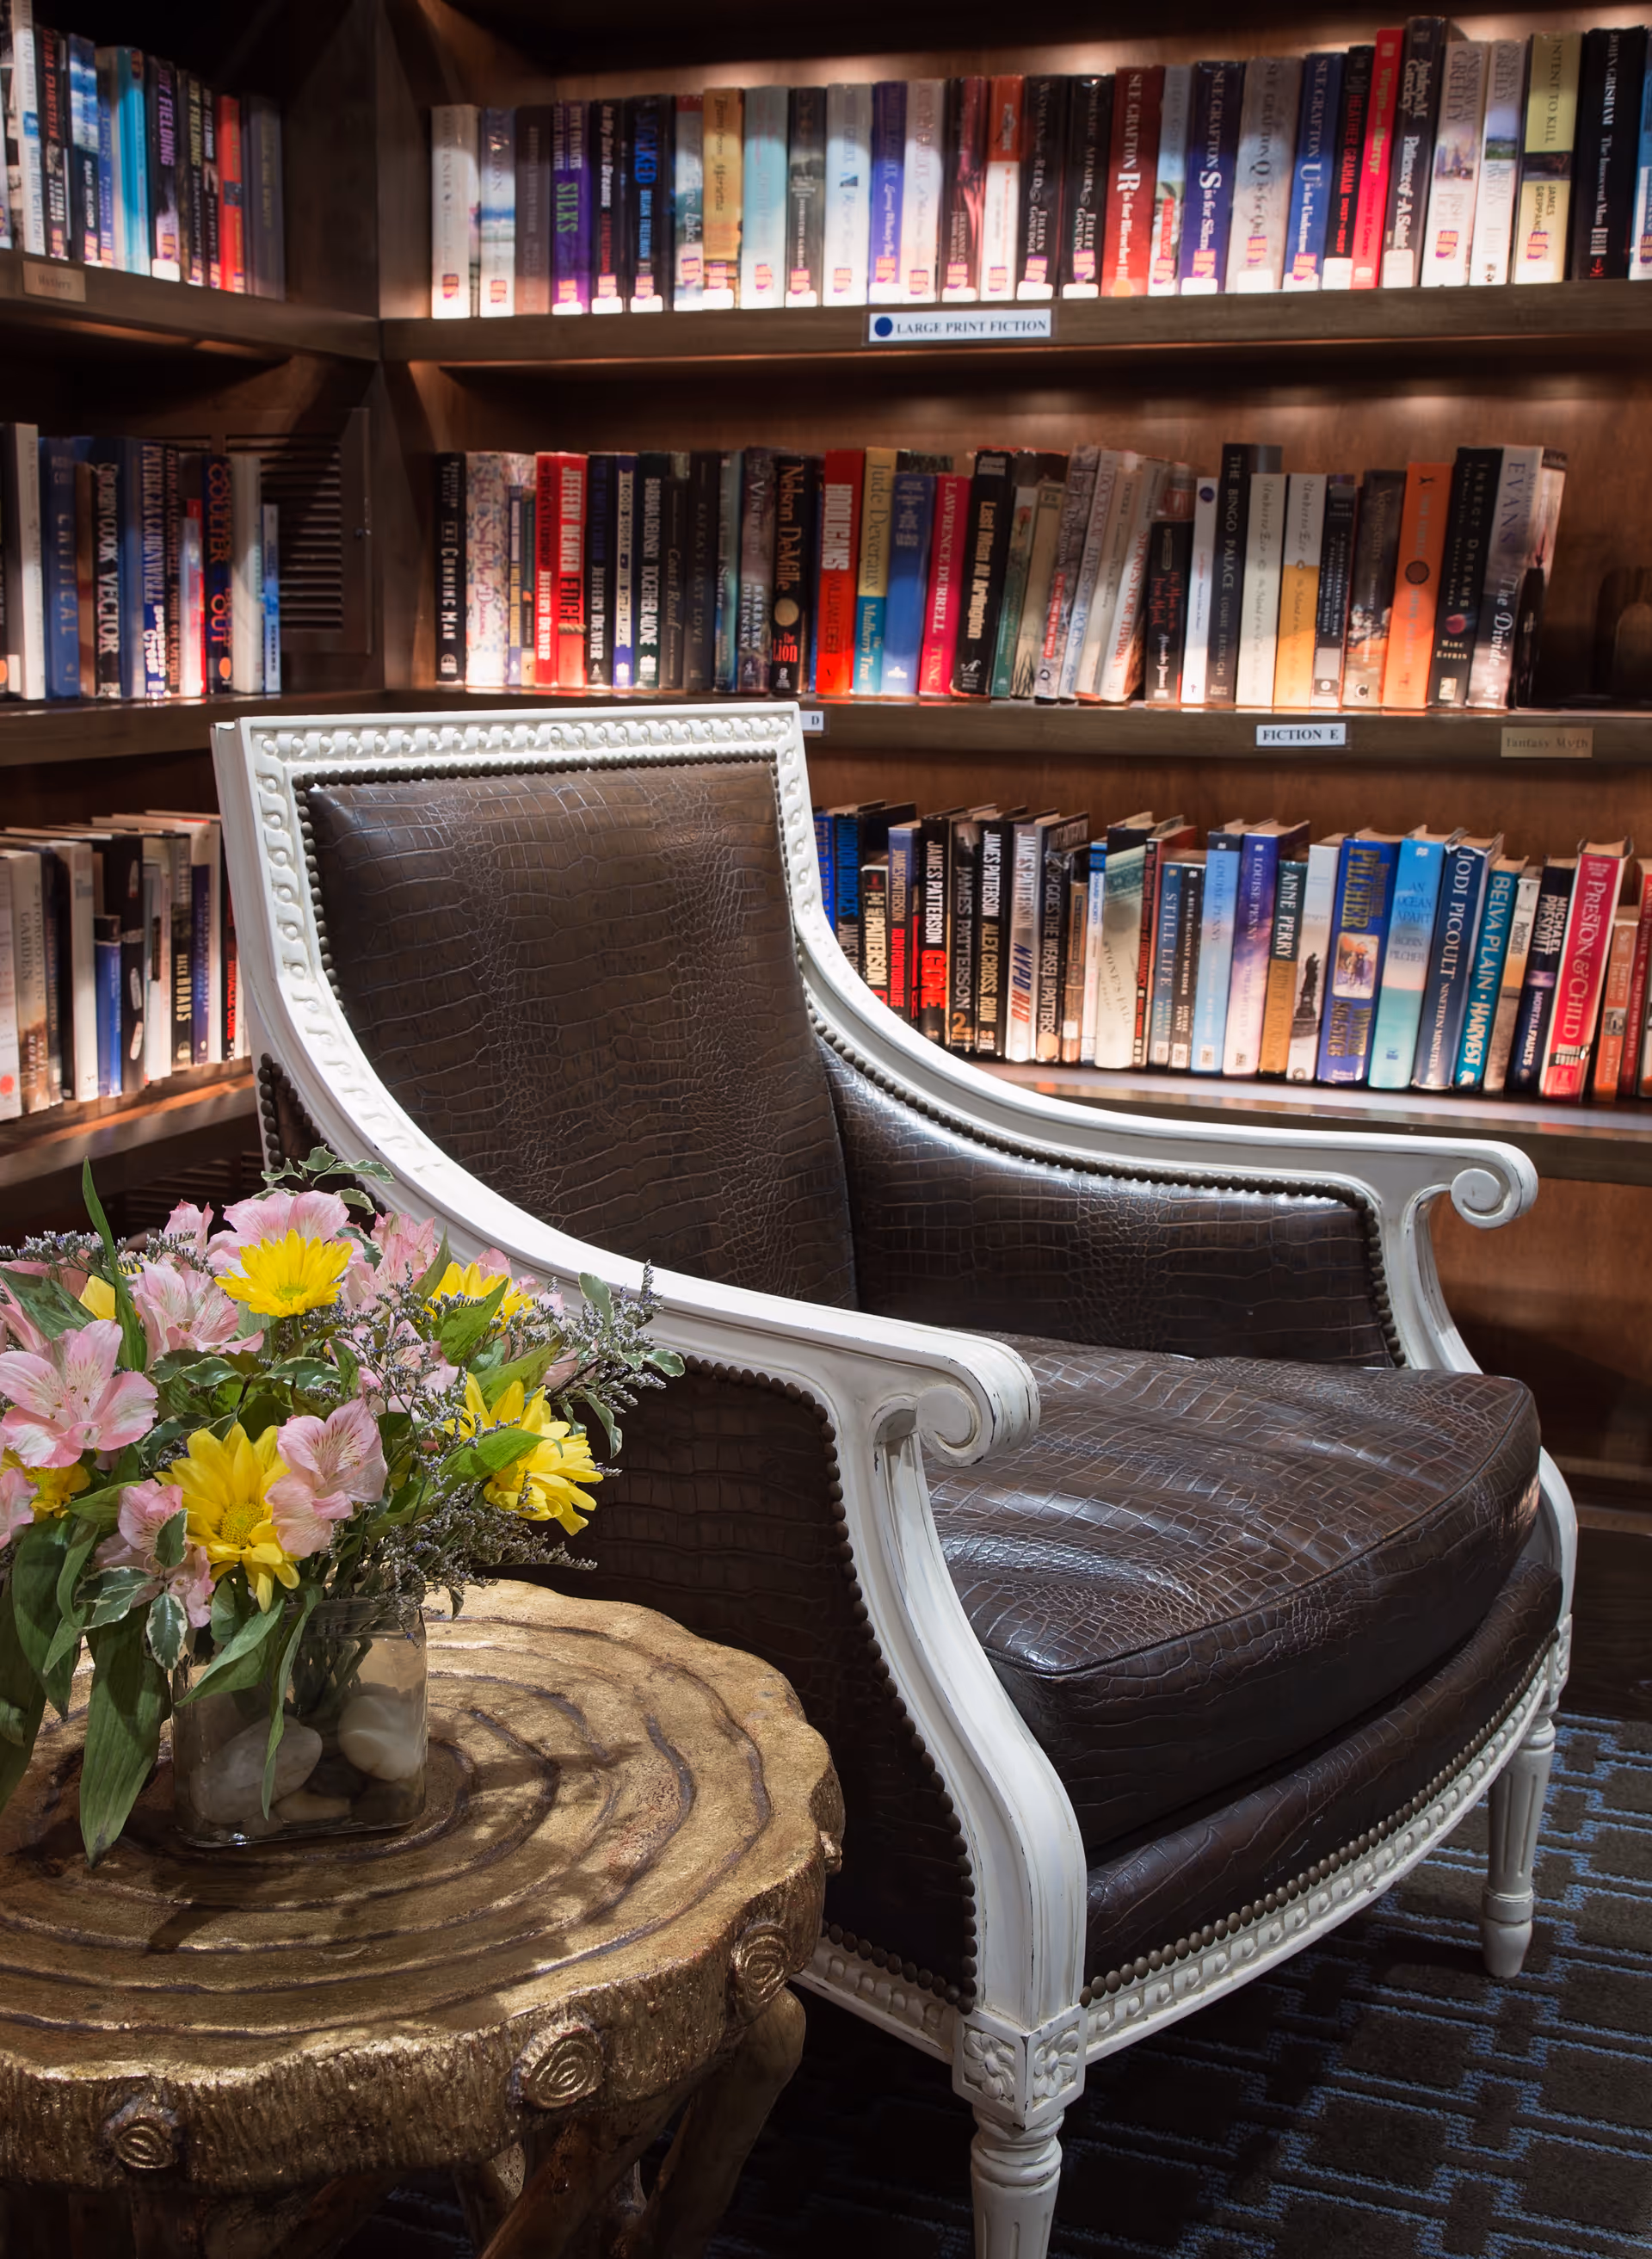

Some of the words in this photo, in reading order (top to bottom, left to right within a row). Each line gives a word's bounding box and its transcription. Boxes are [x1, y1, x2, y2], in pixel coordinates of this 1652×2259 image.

[1549, 39, 1563, 88] INTENT
[1607, 33, 1616, 66] JOHN
[1129, 74, 1142, 101] SUE
[1211, 71, 1224, 97] SUE
[1316, 59, 1328, 85] SUE
[1447, 50, 1466, 121] GREELEY
[46, 74, 59, 139] FAIRSTEIN
[1548, 95, 1559, 112] TO
[1601, 69, 1616, 126] GRISHAM
[159, 97, 174, 166] FIELDING
[189, 106, 200, 166] FIELDING
[1123, 104, 1138, 169] GRAFTON
[1205, 99, 1221, 167] GRAFTON
[1308, 89, 1325, 158] GRAFTON
[1346, 95, 1362, 145] HEATHER
[1544, 115, 1558, 144] KILL
[634, 113, 657, 183] STALKED
[1601, 134, 1612, 156] The
[1118, 172, 1139, 191] R
[1199, 171, 1222, 188] S
[1300, 164, 1321, 181] U
[1340, 148, 1356, 194] GRAHAM
[1598, 157, 1609, 201] Innocent
[55, 181, 64, 221] LETHAL
[86, 188, 95, 227] BLOOD
[557, 183, 578, 233] SILKS
[1122, 203, 1131, 219] for
[1124, 193, 1132, 201] is
[1203, 201, 1216, 217] for
[1547, 186, 1556, 216] JAMES
[1595, 204, 1607, 225] Man
[207, 198, 216, 260] PUPPET
[1027, 207, 1038, 254] GOUDGE
[1037, 210, 1046, 250] EILEEN
[1118, 220, 1131, 264] Ricochet
[897, 323, 941, 334] LARGE
[946, 322, 985, 333] PRINT
[990, 320, 1047, 331] FICTION
[142, 446, 163, 515] PATRICIA
[869, 463, 891, 503] Jude
[1229, 455, 1241, 479] THE
[208, 464, 225, 564] COULTER
[561, 467, 581, 519] JEFFERY
[781, 465, 804, 522] Nelson
[981, 501, 996, 528] Last
[1225, 489, 1238, 532] BINGO
[1501, 461, 1525, 544] EVANS
[99, 519, 118, 562] COOK
[823, 484, 852, 570] HOOLIGANS
[939, 482, 957, 563] LAWRENCE
[143, 518, 163, 603] CORNWELL
[561, 525, 580, 571] DEAVER
[776, 527, 801, 590] DeMille
[864, 509, 887, 589] Deveraux
[977, 532, 993, 560] Man
[1083, 547, 1098, 583] LIVES
[1131, 530, 1149, 583] STONES
[1222, 540, 1236, 589] PALACE
[57, 514, 76, 636] CRITICAL
[441, 547, 458, 606] CUNNING
[592, 566, 604, 611] JEFFERY
[642, 565, 658, 612] TOGETHER
[669, 549, 680, 587] Coast
[695, 567, 706, 601] LAST
[975, 564, 990, 577] At
[1459, 539, 1478, 607] DREAMS
[539, 570, 551, 613] JEFFERY
[668, 590, 681, 629] Road
[933, 566, 950, 633] DURRELL
[967, 578, 989, 639] Arlington
[1124, 587, 1137, 614] FOR
[1497, 577, 1518, 606] The
[98, 572, 118, 655] VECTOR
[210, 594, 225, 644] OUT
[442, 612, 457, 639] MAN
[640, 613, 656, 645] ALONE
[693, 608, 702, 644] LOVE
[740, 584, 750, 649] DELINSKY
[752, 585, 764, 649] BARBARA
[860, 602, 876, 653] Mulberry
[1072, 612, 1088, 647] POETS
[539, 617, 551, 660] DEAVER
[590, 614, 604, 659] DEAVER
[774, 639, 798, 662] Lion
[1489, 612, 1513, 666] Divide
[860, 656, 872, 680] Tree
[929, 645, 943, 686] TUNC
[811, 716, 819, 725] D
[1263, 730, 1322, 740] FICTION
[1330, 730, 1338, 739] E
[837, 819, 857, 867] LONDON
[892, 849, 905, 876] JAMES
[927, 841, 942, 878] JAMES
[983, 830, 1001, 863] JAMES
[1016, 832, 1035, 868] JAMES
[838, 868, 858, 916] BRIDGES
[955, 867, 972, 914] JAMES
[983, 865, 999, 916] PATTERSON
[1250, 858, 1262, 899] LOUISE
[1280, 872, 1298, 909] ANNE
[1341, 848, 1380, 928] PILCHER
[1452, 852, 1475, 894] JODI
[891, 876, 904, 921] PATTERSON
[925, 881, 942, 943] PATTERSON
[1014, 871, 1033, 929] PATTERSON
[1046, 885, 1060, 914] GOES
[1163, 892, 1177, 941] STILL
[1489, 875, 1510, 929] BELVA
[1573, 880, 1606, 958] PRESTON
[839, 923, 858, 954] JAMES
[891, 928, 904, 949] RUN
[982, 923, 999, 950] ALEX
[1045, 915, 1059, 937] THE
[1248, 904, 1260, 942] PENNY
[1275, 916, 1295, 957] PERRY
[1439, 902, 1465, 979] PICOULT
[1532, 894, 1556, 954] PRESCOTT
[1549, 898, 1569, 954] MICHAEL
[21, 912, 32, 980] GARDEN
[176, 954, 188, 975] BACK
[866, 917, 886, 984] PATTERSON
[891, 950, 904, 966] FOR
[956, 920, 971, 1009] PATTERSON
[1013, 943, 1032, 991] NYPD
[1041, 938, 1058, 977] WEASEL
[1160, 948, 1174, 987] LIFE
[1476, 935, 1501, 990] PLAIN
[891, 966, 904, 989] YOUR
[922, 950, 946, 1009] GONE
[979, 954, 996, 995] CROSS,
[1180, 960, 1190, 995] MURDER
[1573, 959, 1588, 978] &
[176, 978, 192, 1021] ROADS
[891, 990, 903, 1007] LIFE
[980, 997, 996, 1021] RUN
[1012, 991, 1029, 1022] RED
[1175, 1006, 1184, 1031] PENNY
[1433, 983, 1449, 1028] NINETEEN
[1563, 978, 1587, 1039] CHILD
[1328, 1000, 1351, 1056] SOLSTICE
[1347, 1007, 1372, 1056] WINTER
[1429, 1029, 1444, 1069] MINUTES
[1463, 1002, 1490, 1065] HARVEST
